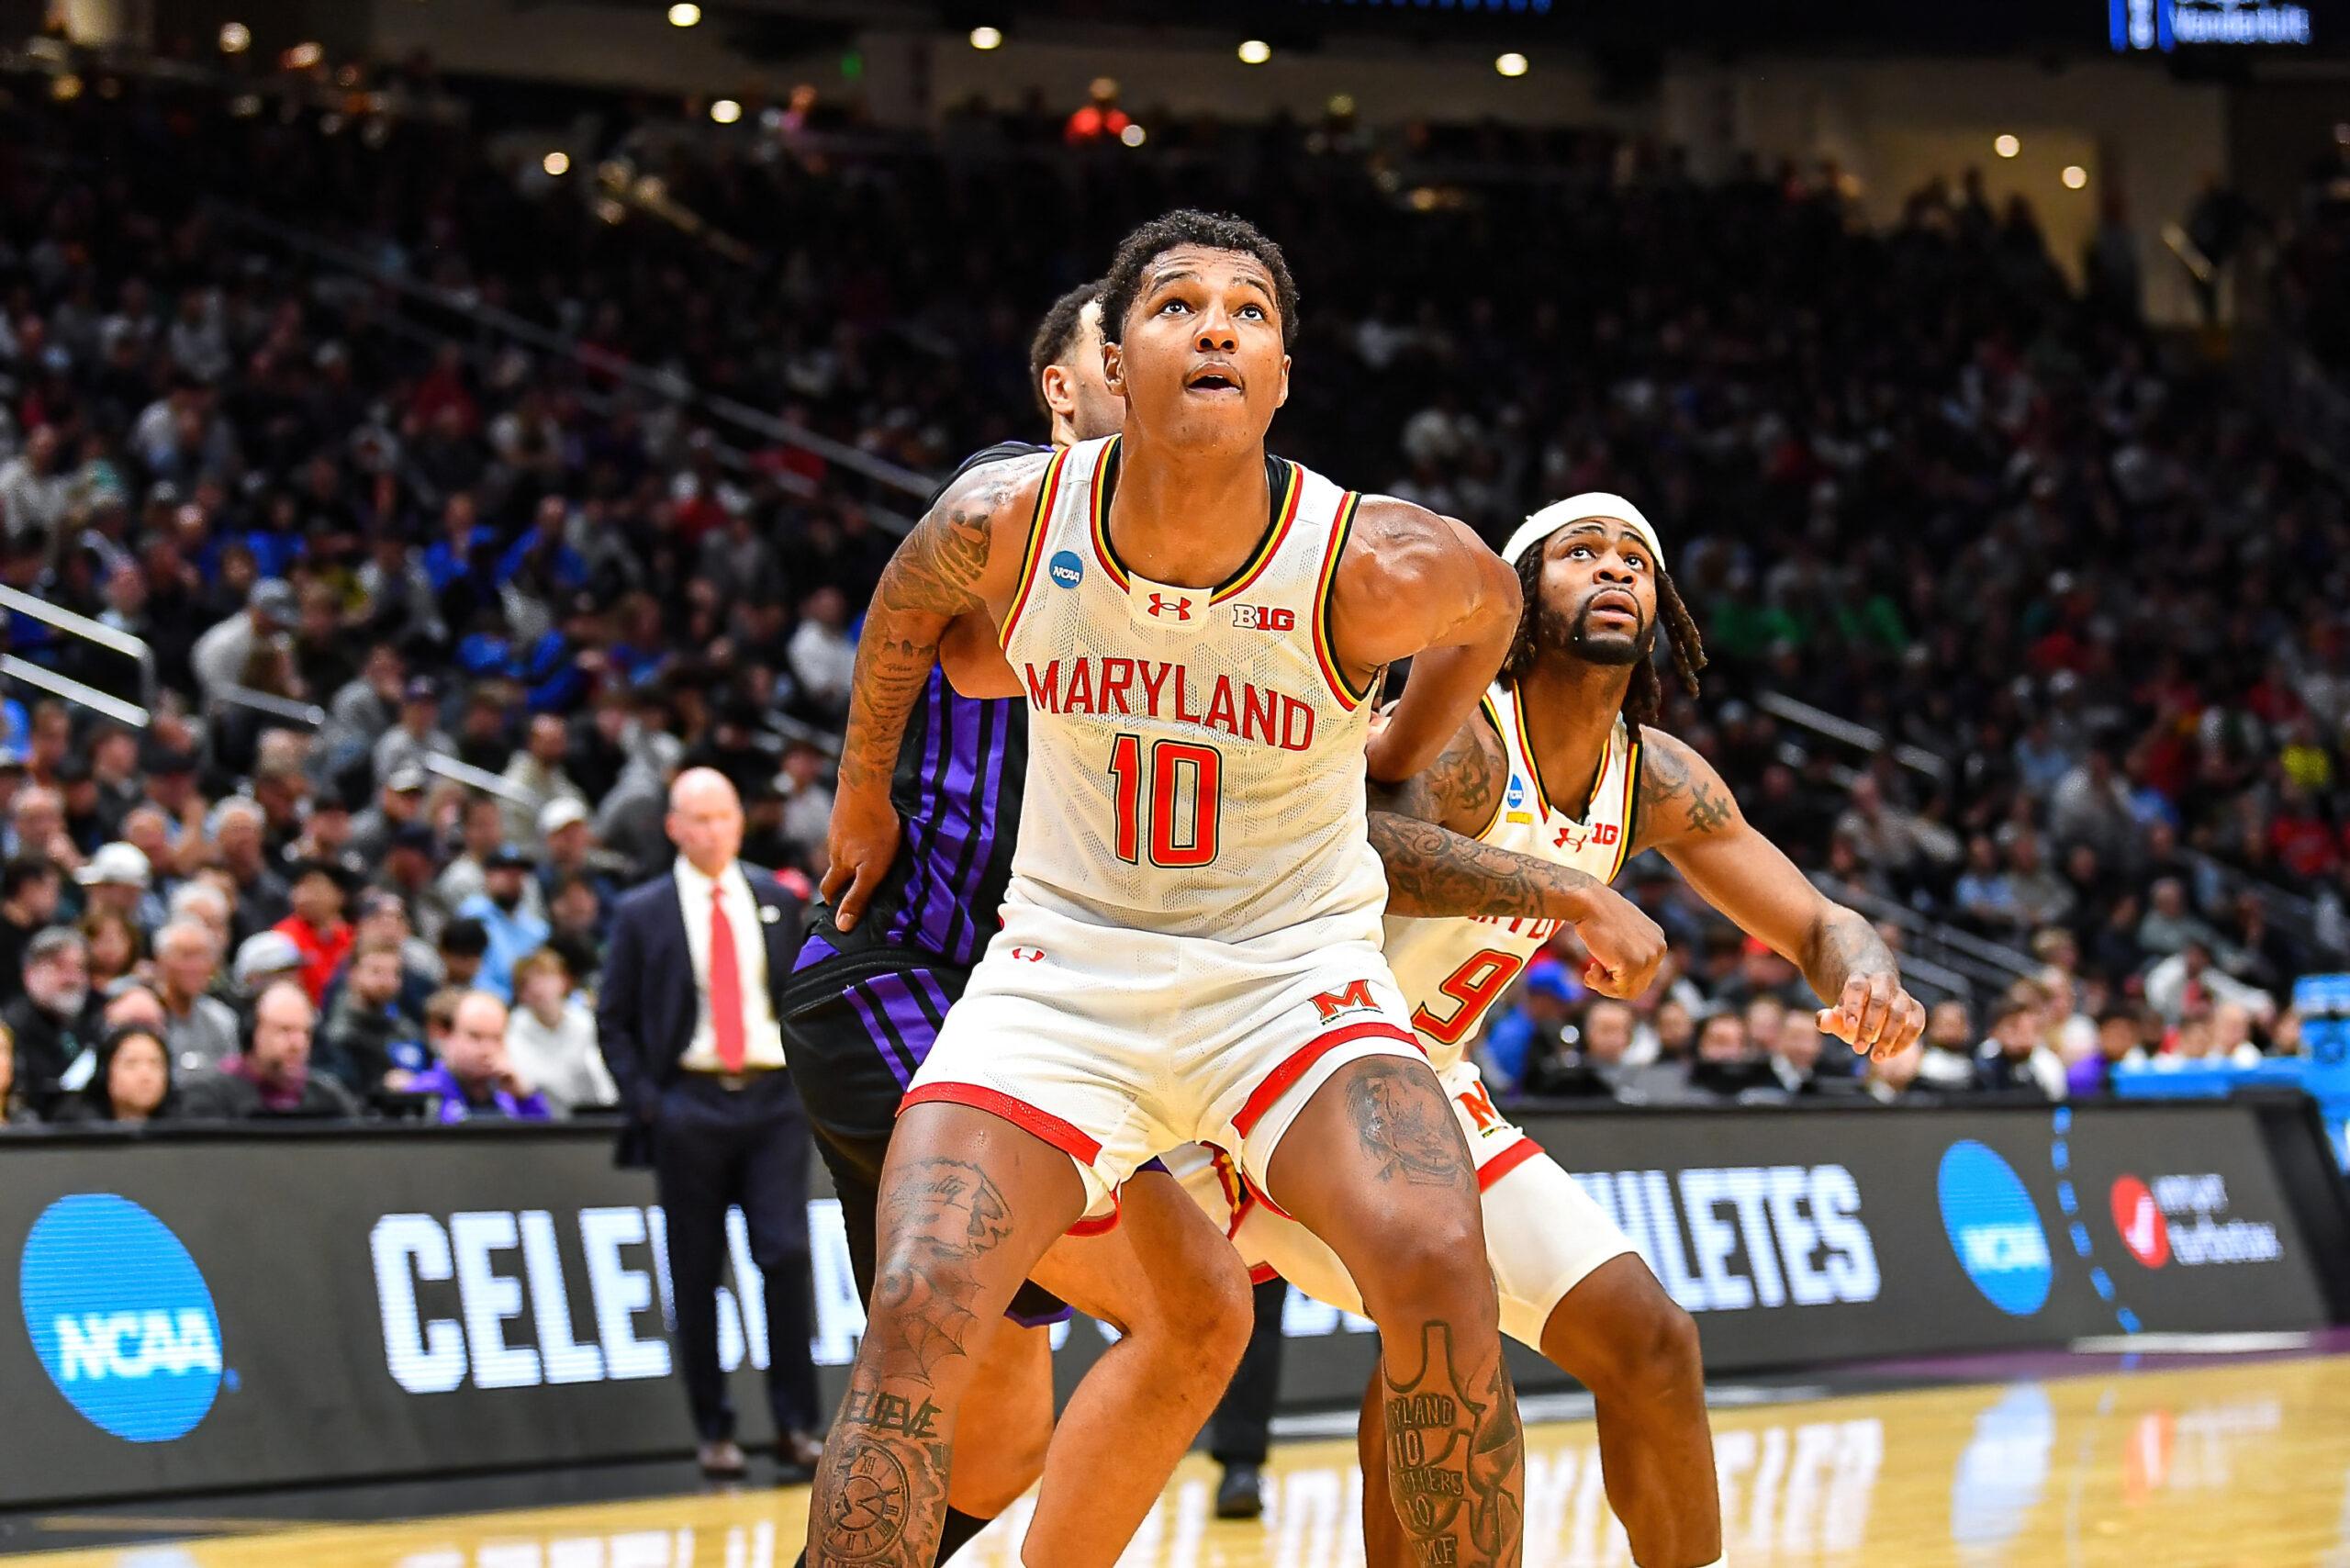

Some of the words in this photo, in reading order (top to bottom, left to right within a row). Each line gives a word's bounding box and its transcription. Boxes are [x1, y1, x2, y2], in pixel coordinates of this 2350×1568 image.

[1052, 566, 1080, 583] NCAA
[1024, 656, 1315, 752] MARYLAND
[1108, 733, 1222, 868] 10
[1410, 948, 1523, 1045] 9
[52, 1307, 223, 1382] NCAA
